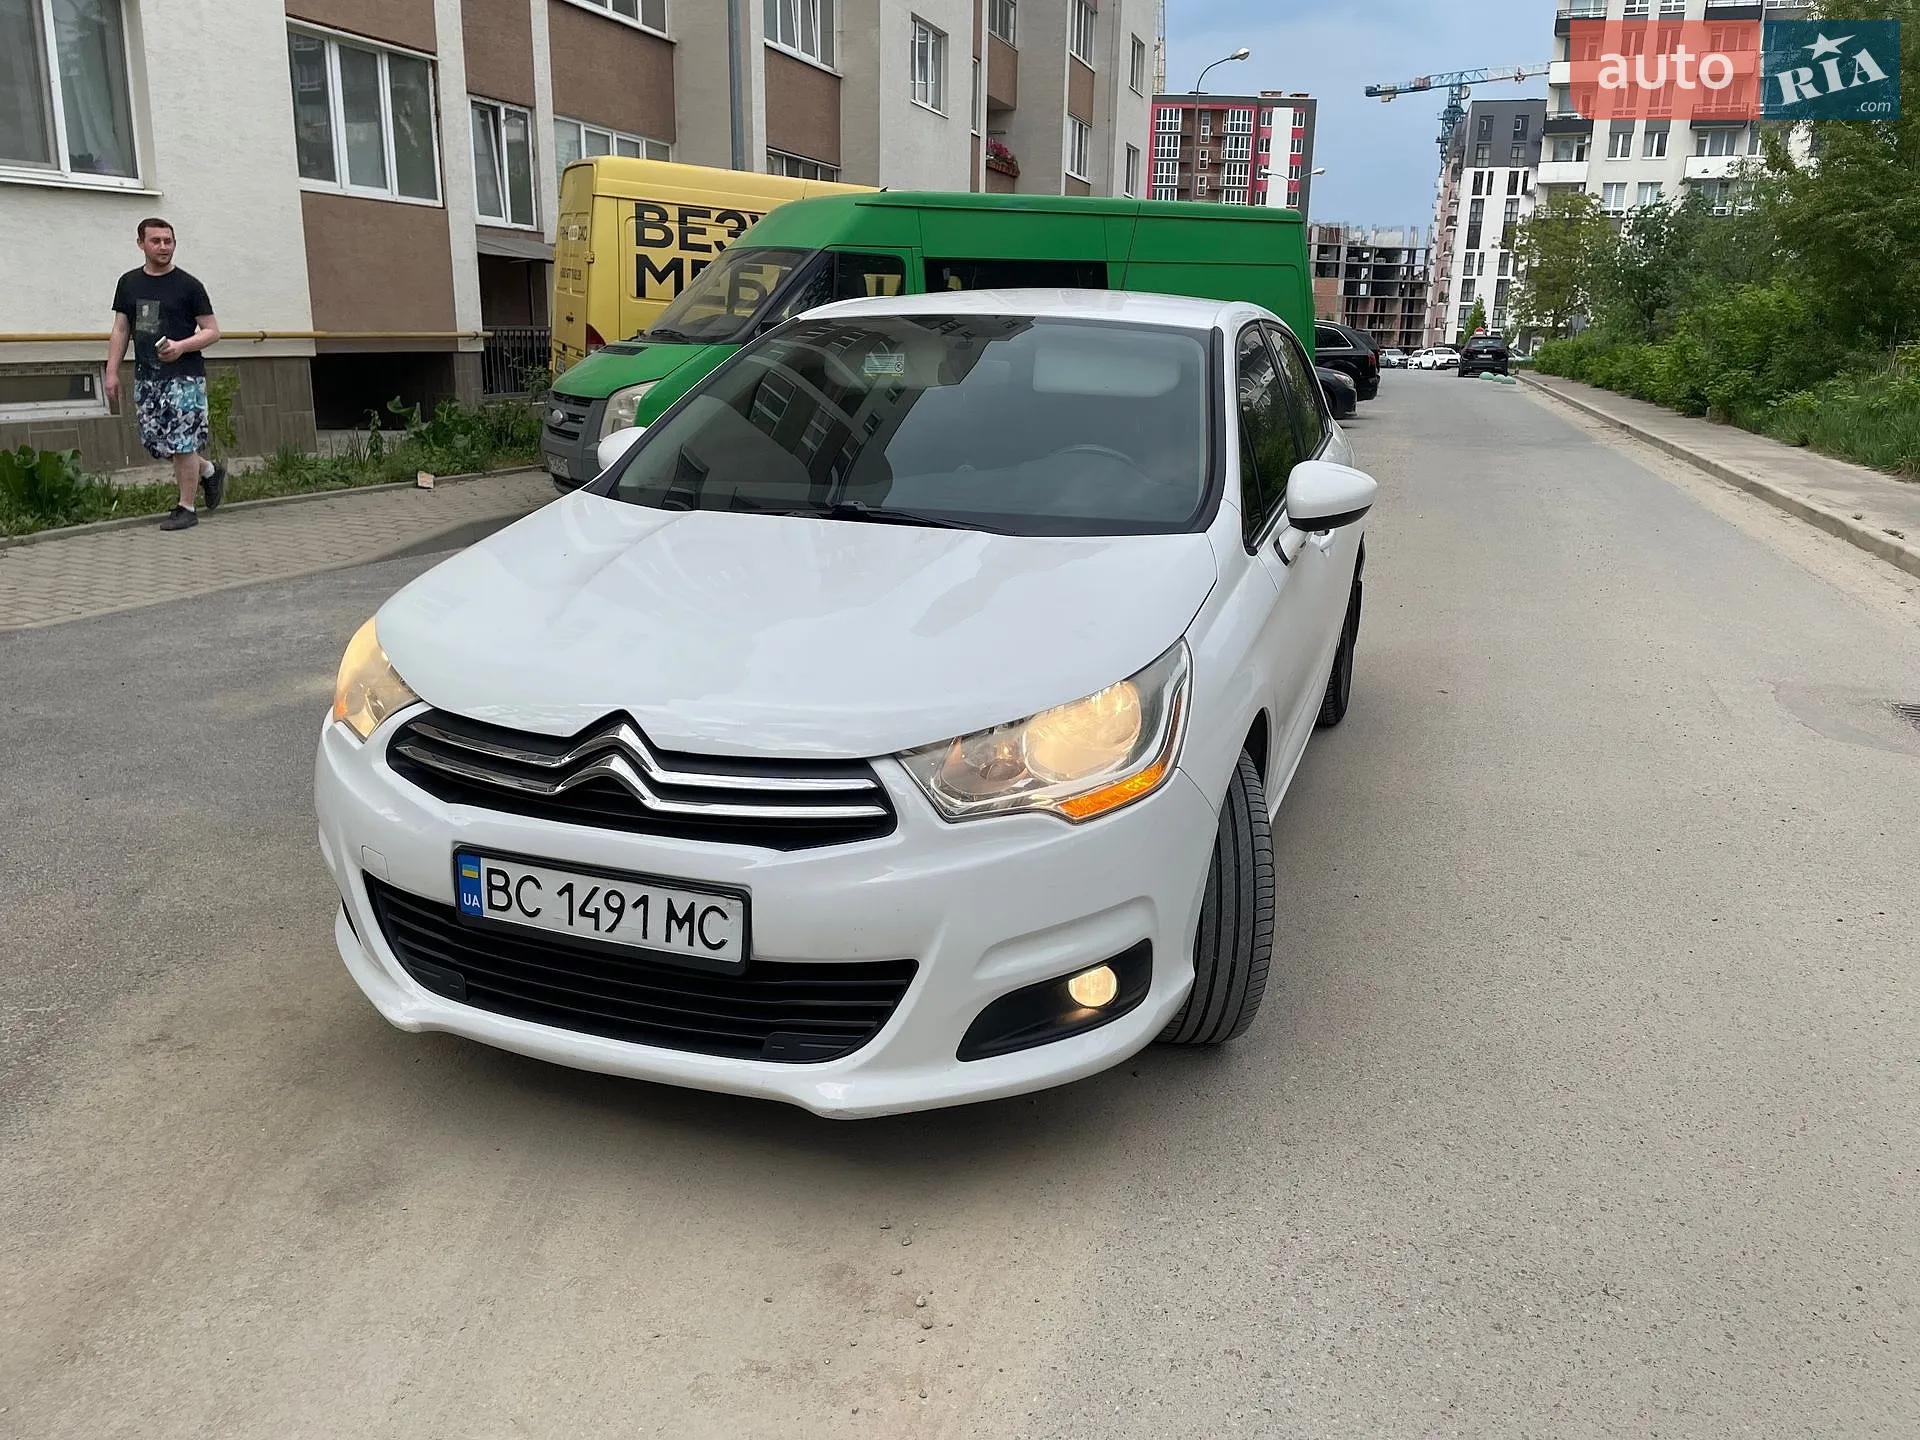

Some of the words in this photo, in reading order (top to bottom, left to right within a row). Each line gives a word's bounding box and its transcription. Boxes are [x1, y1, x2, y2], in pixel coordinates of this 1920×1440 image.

[635, 202, 760, 253] ВЕЗ
[463, 893, 480, 908] UA
[487, 867, 543, 918] BC
[557, 882, 649, 939] 1491
[665, 897, 729, 950] MC
